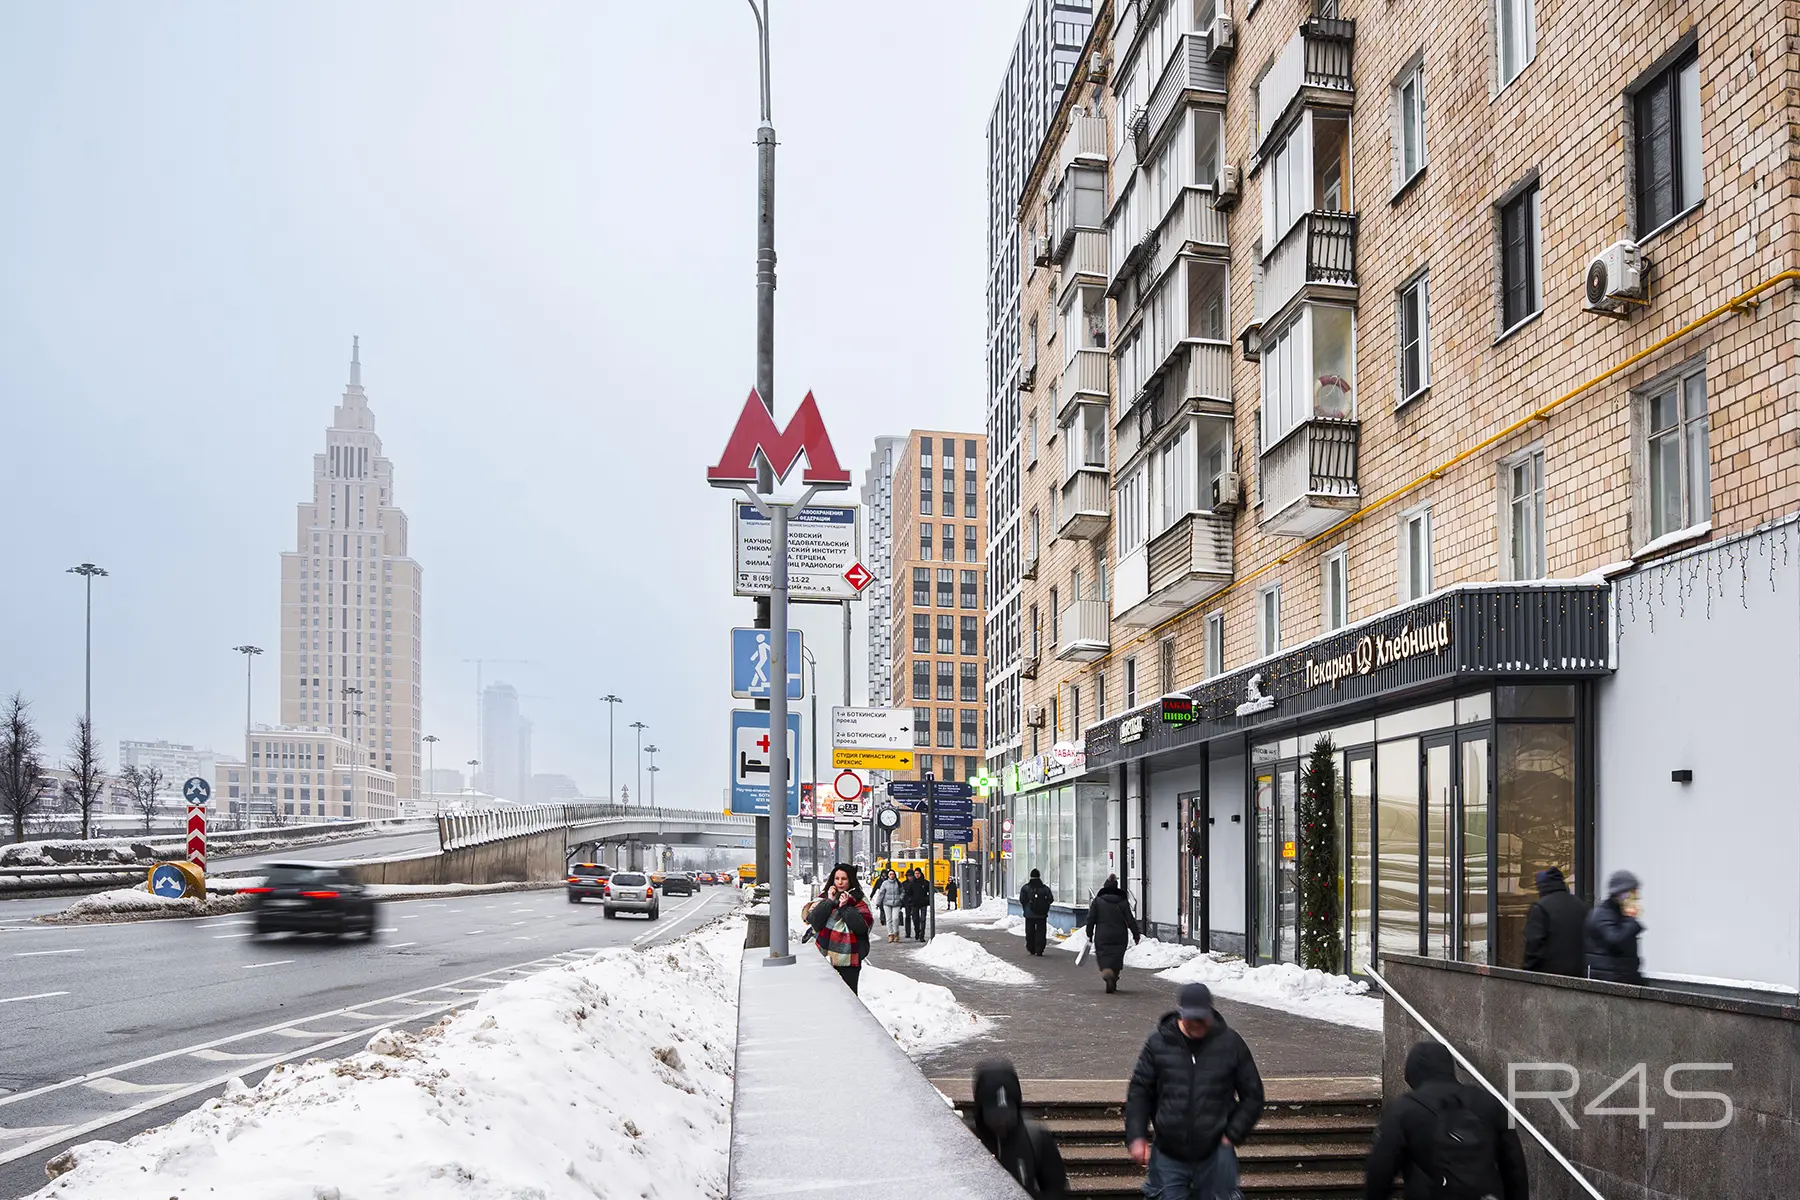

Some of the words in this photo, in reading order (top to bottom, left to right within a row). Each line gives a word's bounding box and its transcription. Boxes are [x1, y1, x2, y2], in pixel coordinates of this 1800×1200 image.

[788, 531, 823, 539] КОВСКИЙ
[811, 547, 847, 555] ИНСТИТУТ
[1305, 653, 1353, 689] Пекарня
[1375, 619, 1449, 667] Хлебница
[1162, 700, 1191, 710] ТАБАК
[1163, 712, 1191, 721] ПИВО
[846, 731, 887, 739] БОТКИНСКИЙ
[858, 752, 896, 760] ГИМНАСТИКИ
